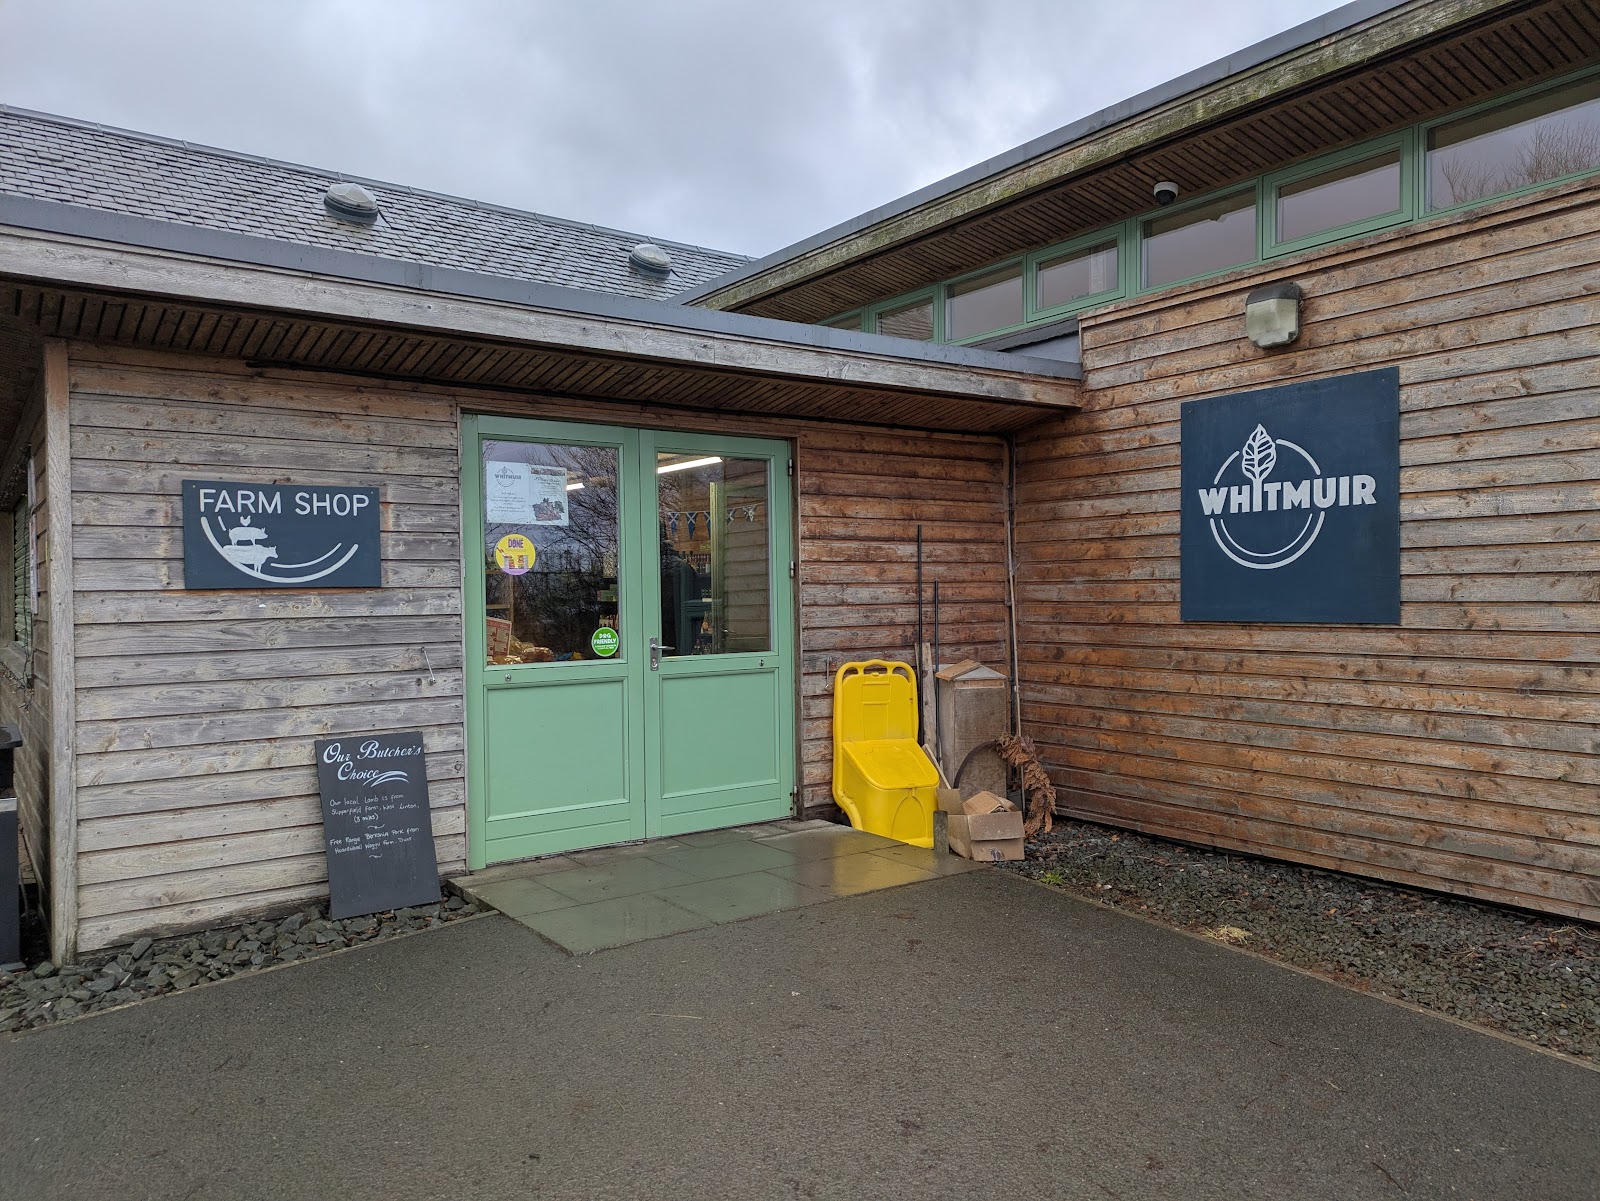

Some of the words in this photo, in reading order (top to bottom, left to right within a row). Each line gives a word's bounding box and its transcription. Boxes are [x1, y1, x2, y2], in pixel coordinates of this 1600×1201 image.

[199, 488, 282, 514] FARM
[295, 491, 370, 516] SHOP
[1198, 474, 1377, 516] WHITMUIR
[323, 743, 351, 763] Our
[357, 740, 422, 760] Butcher's
[337, 761, 380, 781] Choice
[329, 799, 342, 807] Our
[344, 797, 360, 805] local
[390, 794, 404, 802] from
[329, 838, 342, 846] Free
[345, 836, 361, 844] Range
